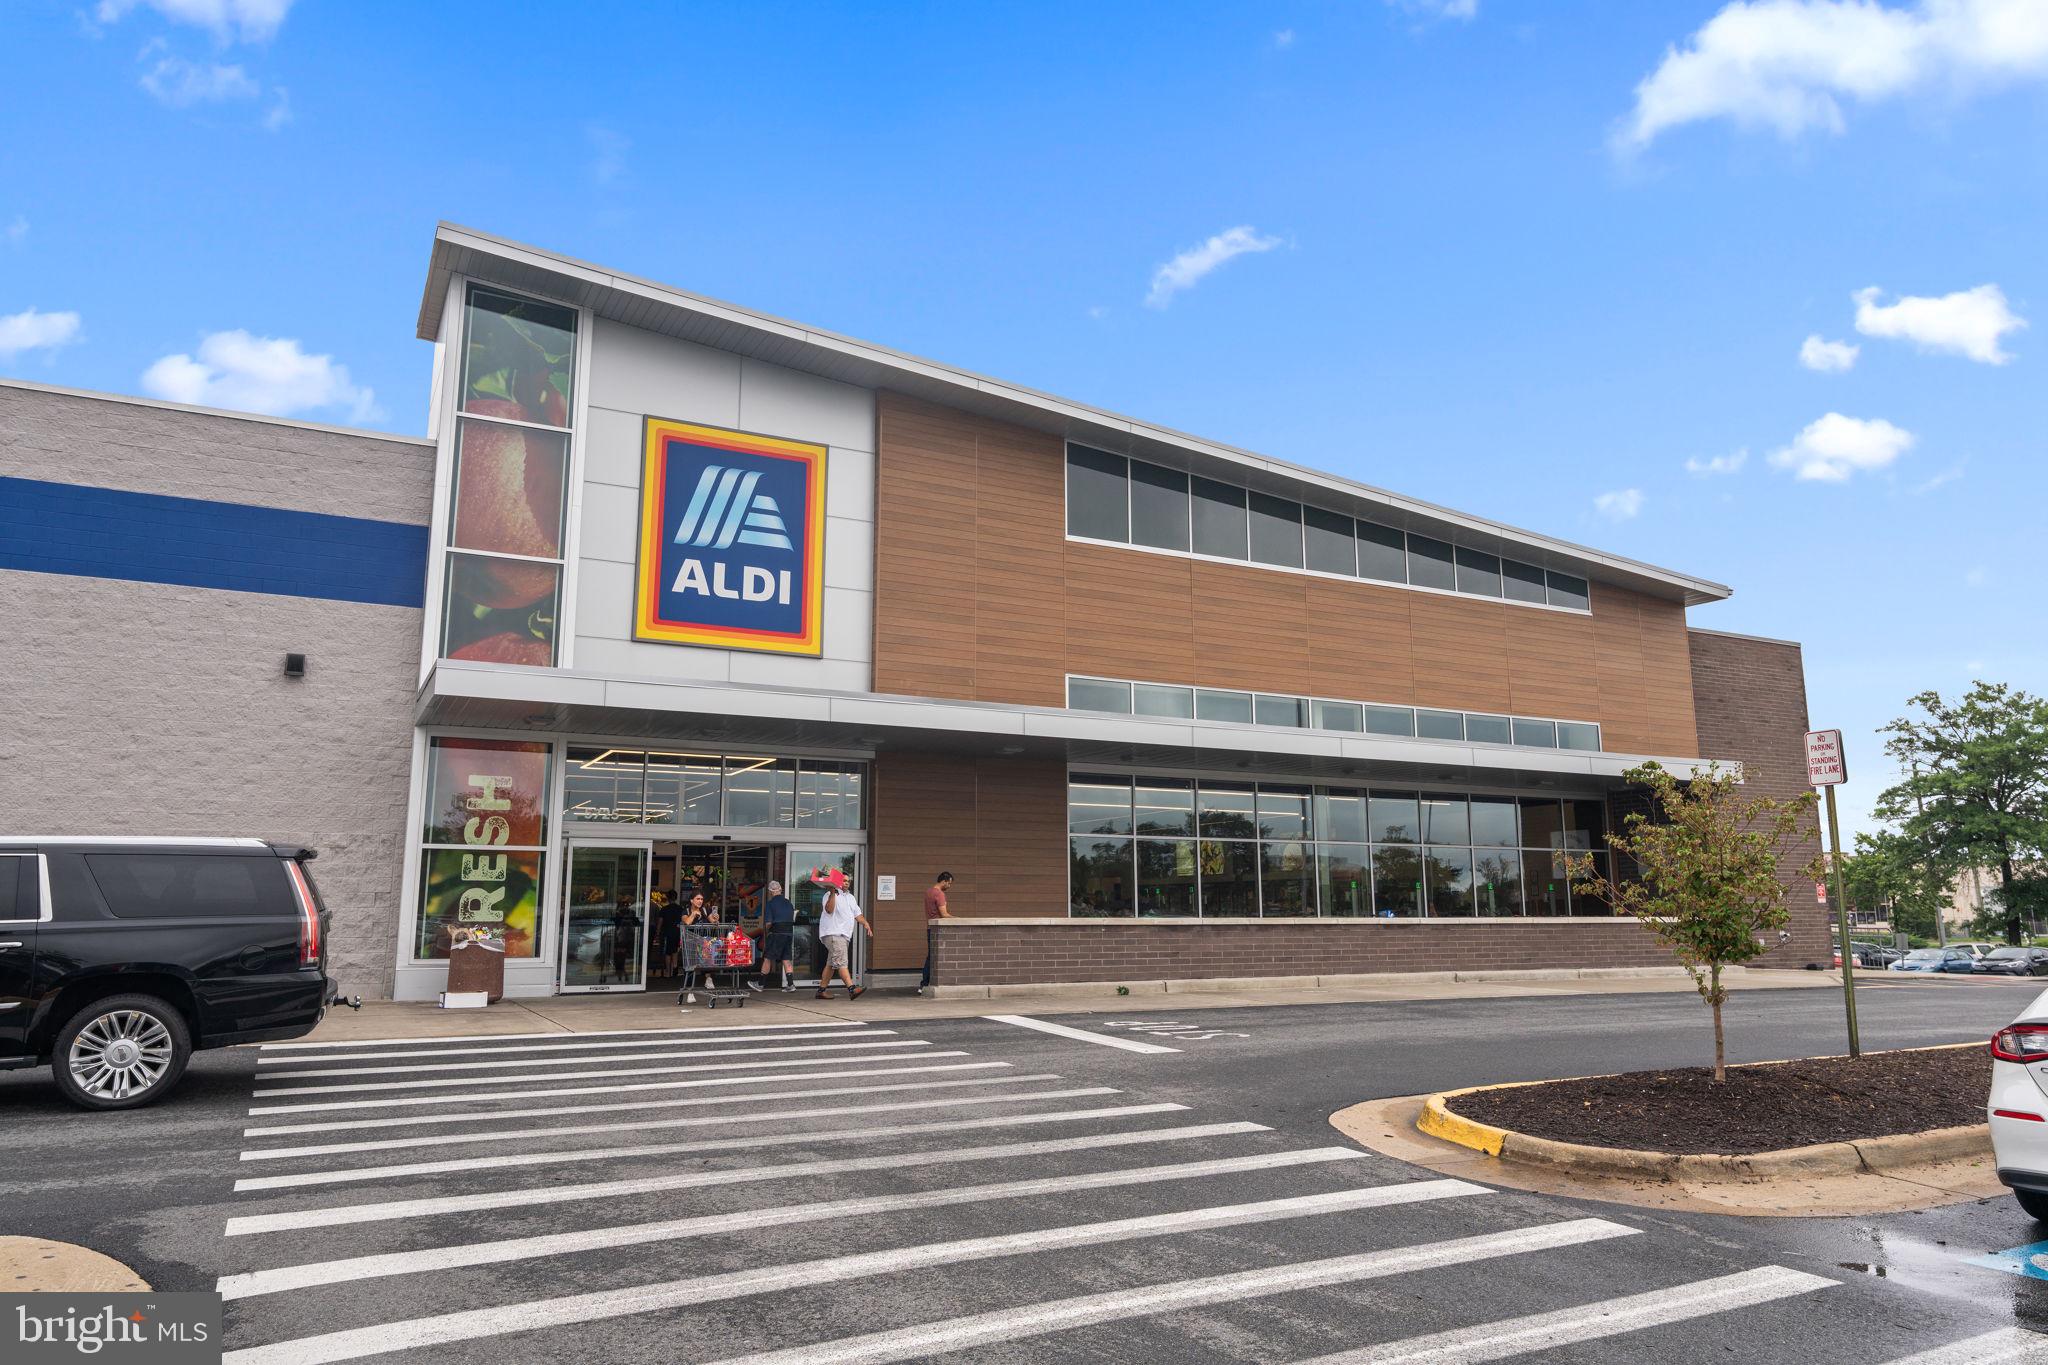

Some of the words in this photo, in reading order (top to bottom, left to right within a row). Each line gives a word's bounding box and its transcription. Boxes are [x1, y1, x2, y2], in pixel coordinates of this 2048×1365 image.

[672, 558, 791, 605] ALDI
[1817, 735, 1826, 743] NO
[1810, 743, 1835, 752] PARKING
[1810, 756, 1838, 765] STANDING
[1810, 766, 1823, 776] FIRE
[1824, 764, 1841, 775] LANE
[458, 774, 513, 922] RESH
